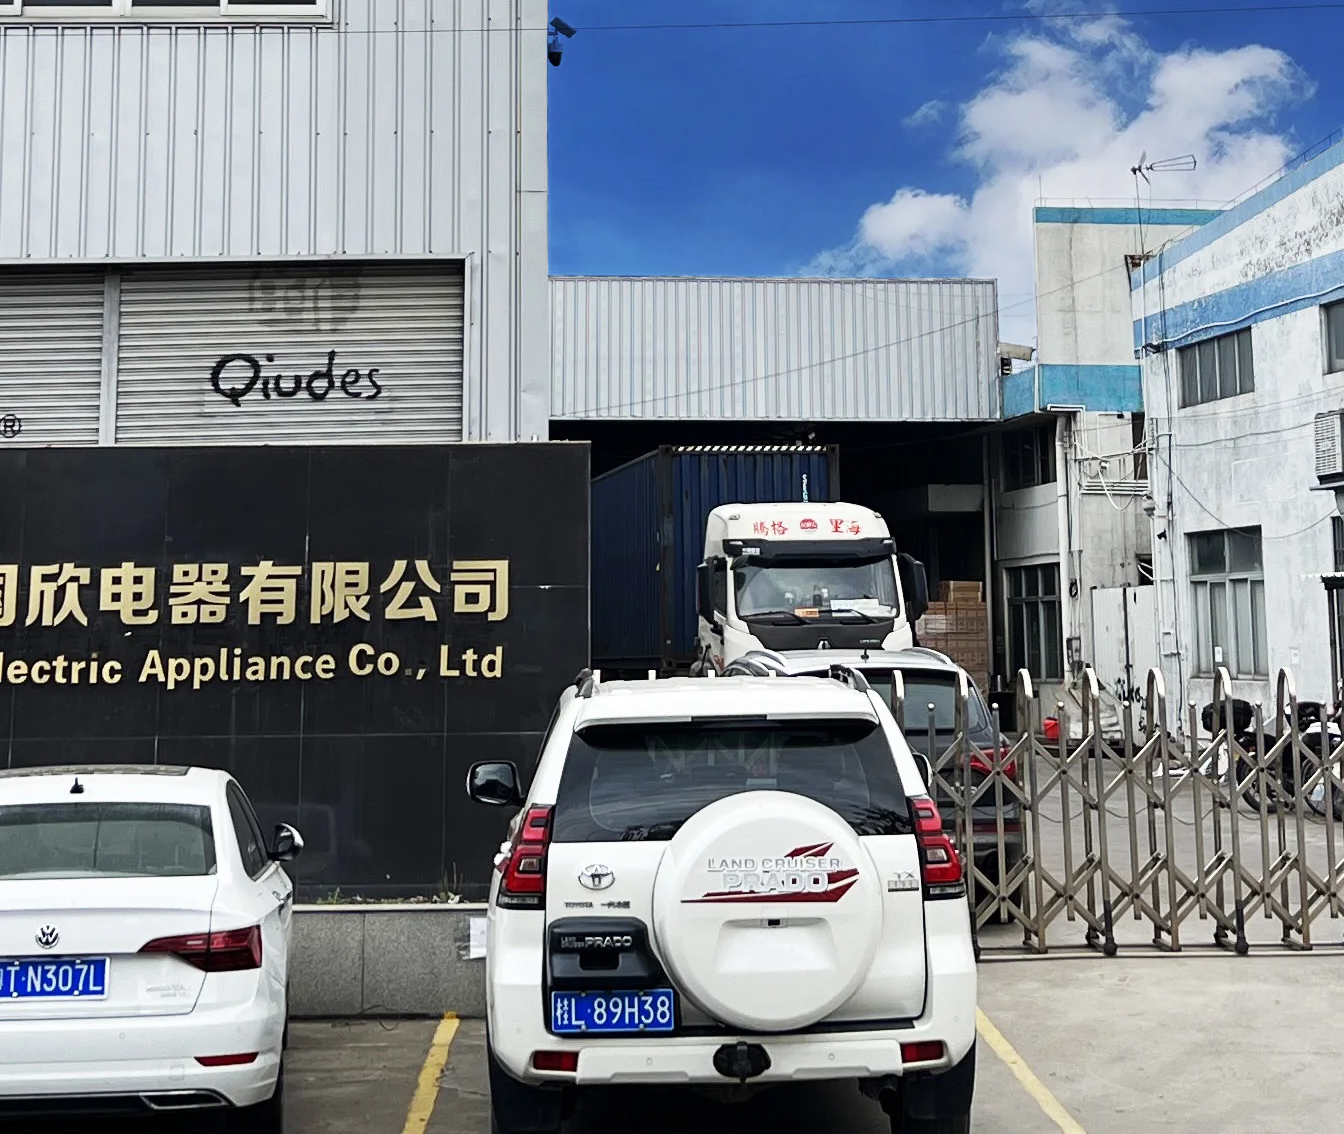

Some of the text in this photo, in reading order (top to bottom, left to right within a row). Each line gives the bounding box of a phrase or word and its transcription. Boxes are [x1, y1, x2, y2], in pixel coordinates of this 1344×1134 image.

[209, 349, 383, 407] Qiudes
[138, 647, 336, 690] Appliance
[439, 644, 504, 679] Ltd
[721, 871, 829, 893] PRADO
